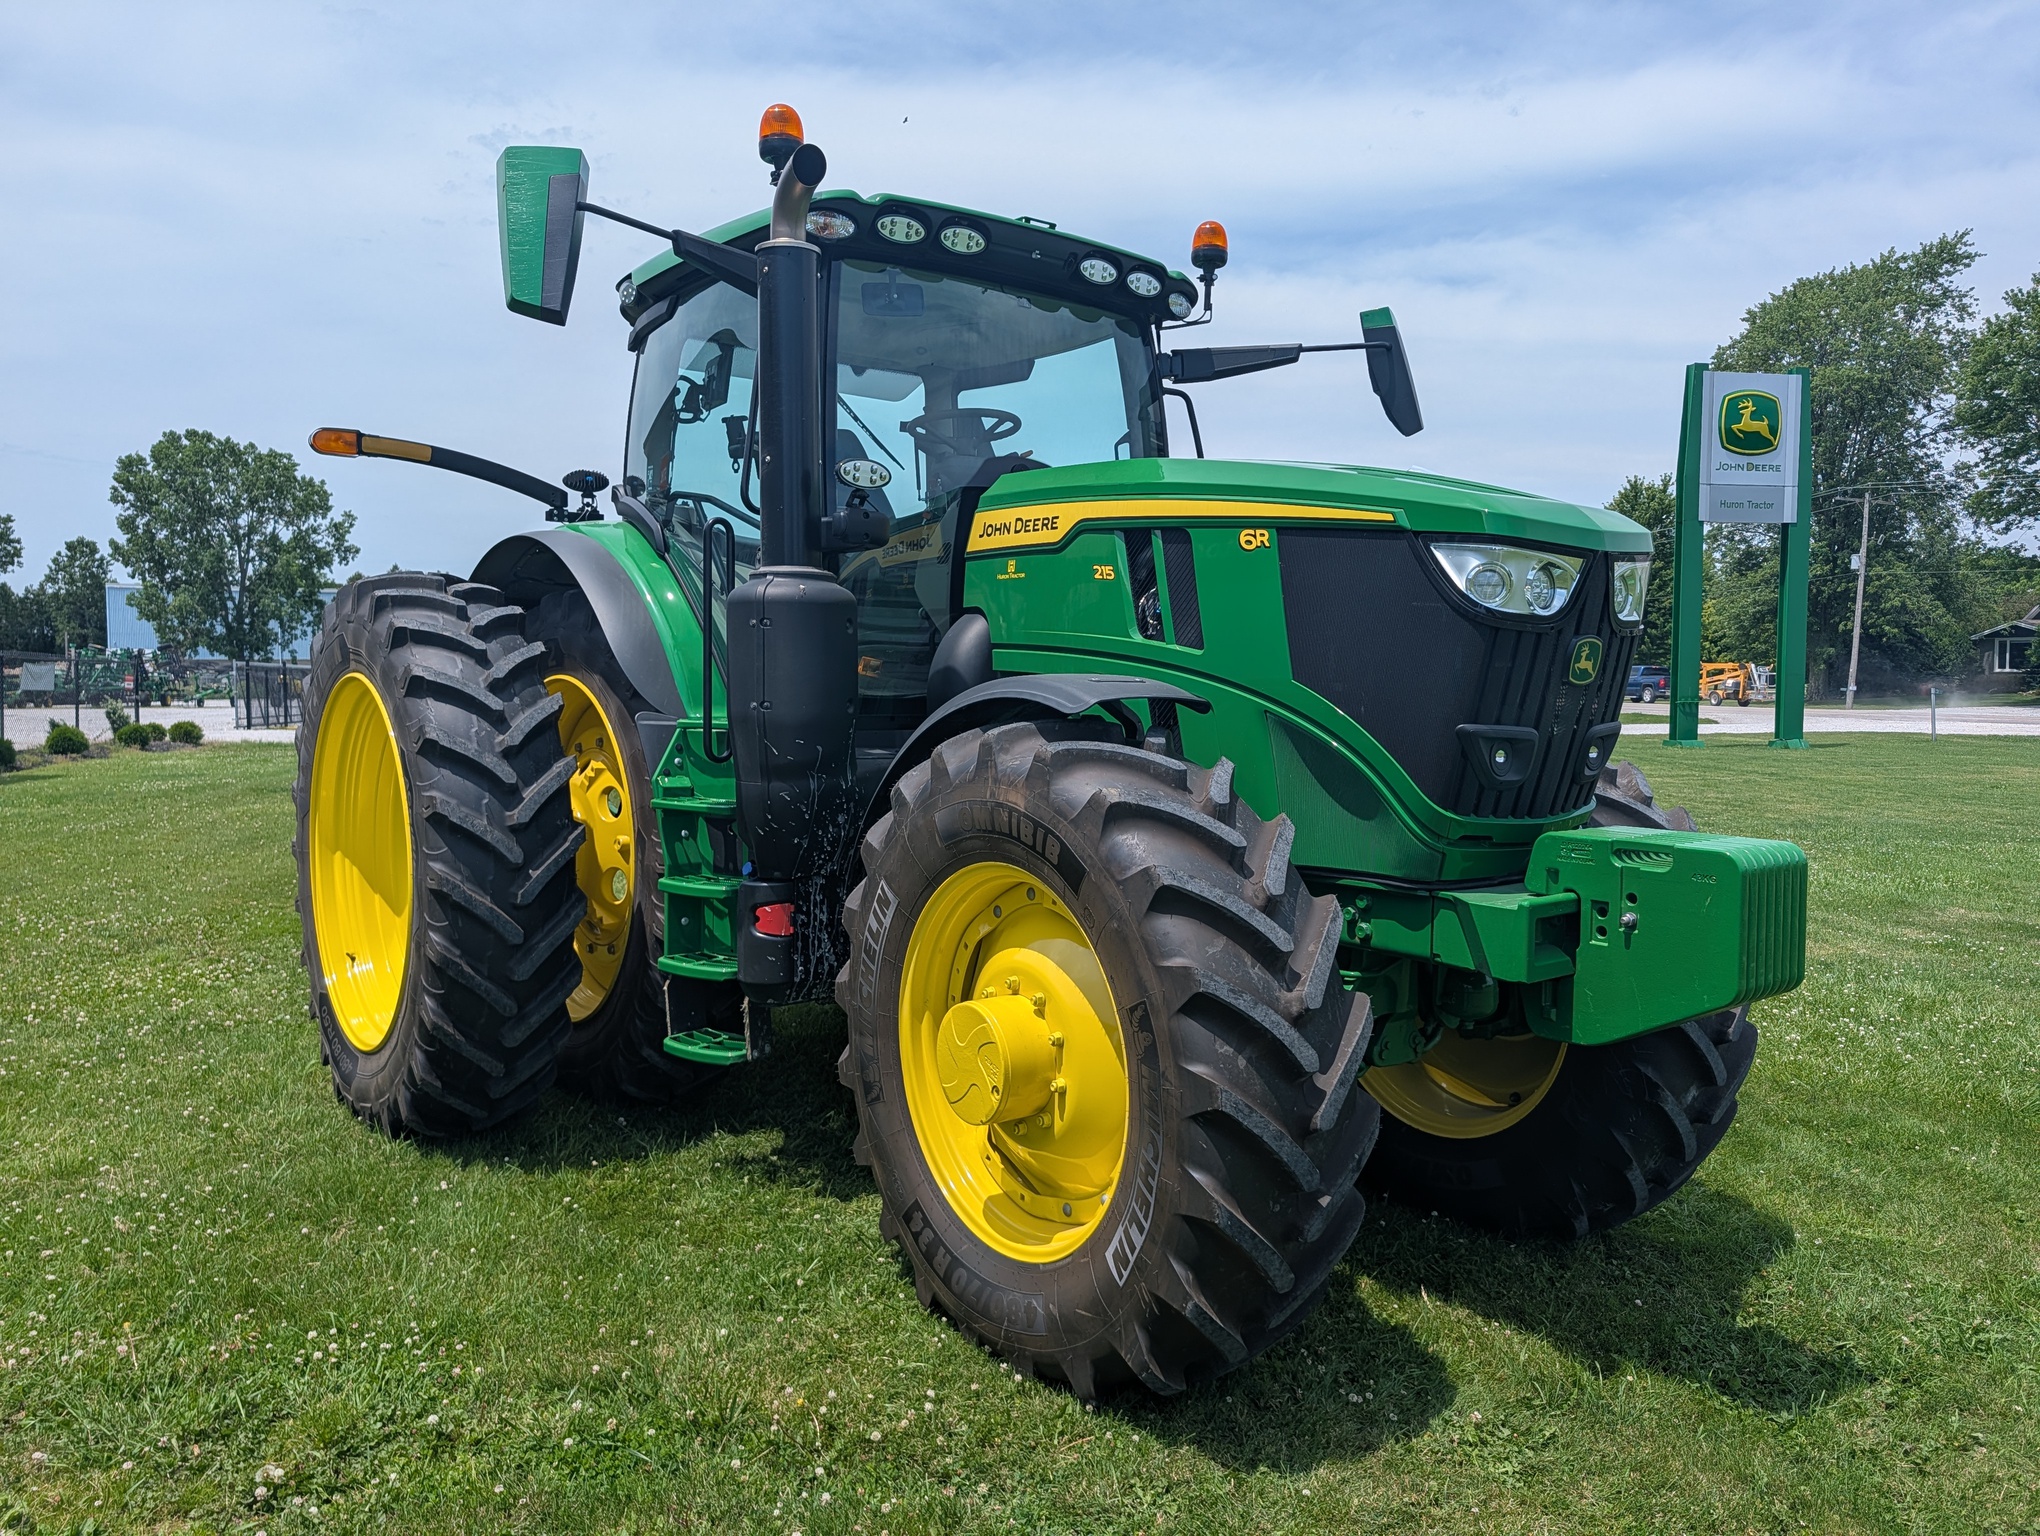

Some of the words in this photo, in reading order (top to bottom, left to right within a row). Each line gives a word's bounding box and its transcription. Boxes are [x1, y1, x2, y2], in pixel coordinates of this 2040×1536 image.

[1715, 461, 1744, 471] JOHN
[1746, 462, 1782, 472] DEERE
[1719, 499, 1744, 509] Huron
[1747, 500, 1775, 510] Tractor
[978, 521, 1011, 538] JOHN
[1013, 515, 1059, 534] DEERE
[1238, 528, 1271, 552] 6R
[1092, 564, 1115, 580] 215
[957, 805, 1061, 866] OMNIBIB
[858, 880, 895, 1054] MICHELIN
[1110, 1063, 1162, 1282] MICHELIN
[951, 1267, 1038, 1329] 480/70
